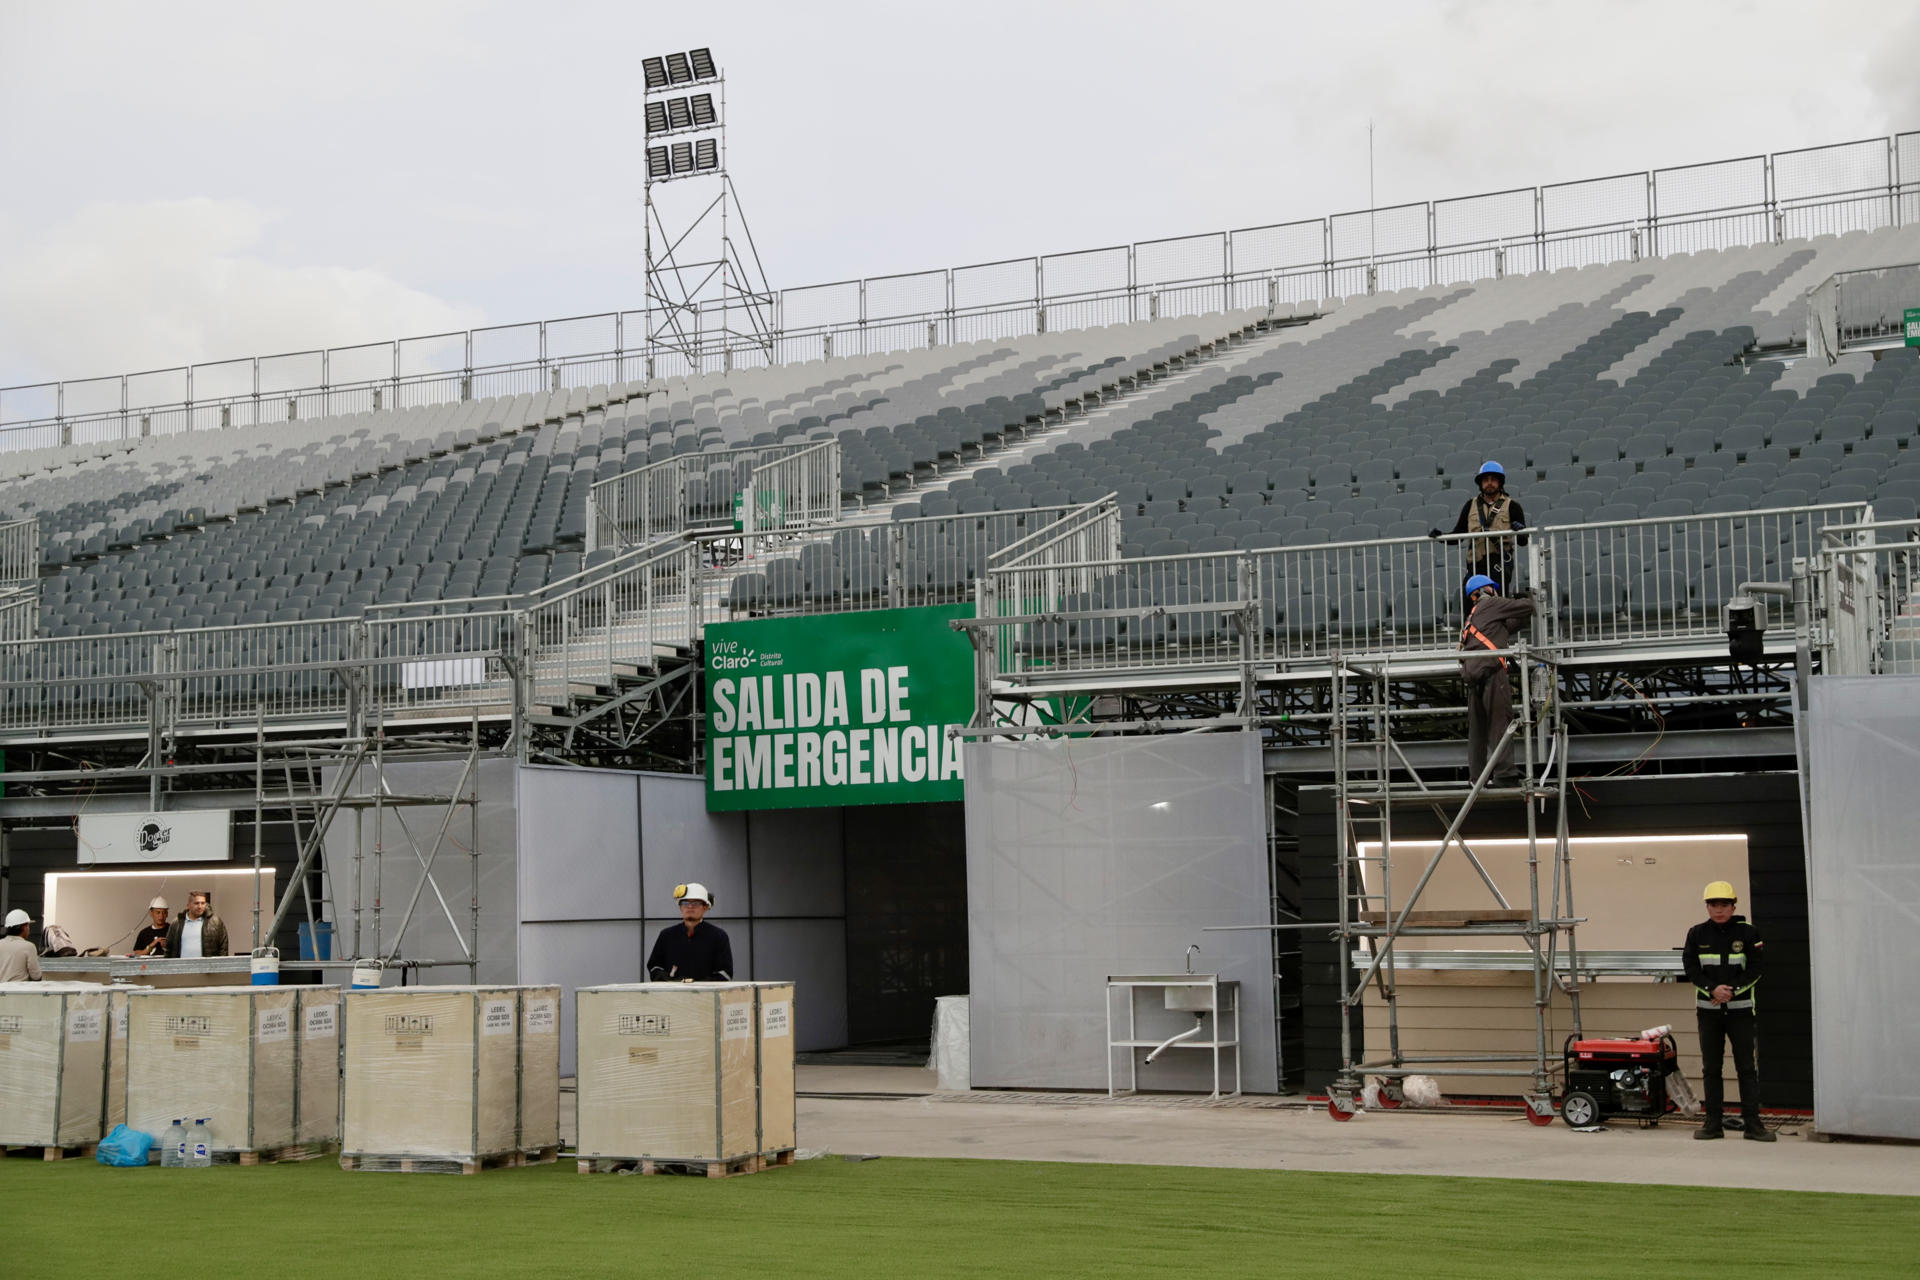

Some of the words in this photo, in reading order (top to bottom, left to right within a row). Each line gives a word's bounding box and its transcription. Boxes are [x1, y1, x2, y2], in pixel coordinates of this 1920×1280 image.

[712, 638, 738, 654] vive
[712, 655, 750, 670] Claro
[760, 653, 782, 661] Distrito
[760, 659, 784, 667] Cultural
[713, 670, 850, 733] SALIDA
[860, 665, 911, 724] DE
[713, 723, 965, 792] EMERGENCIA
